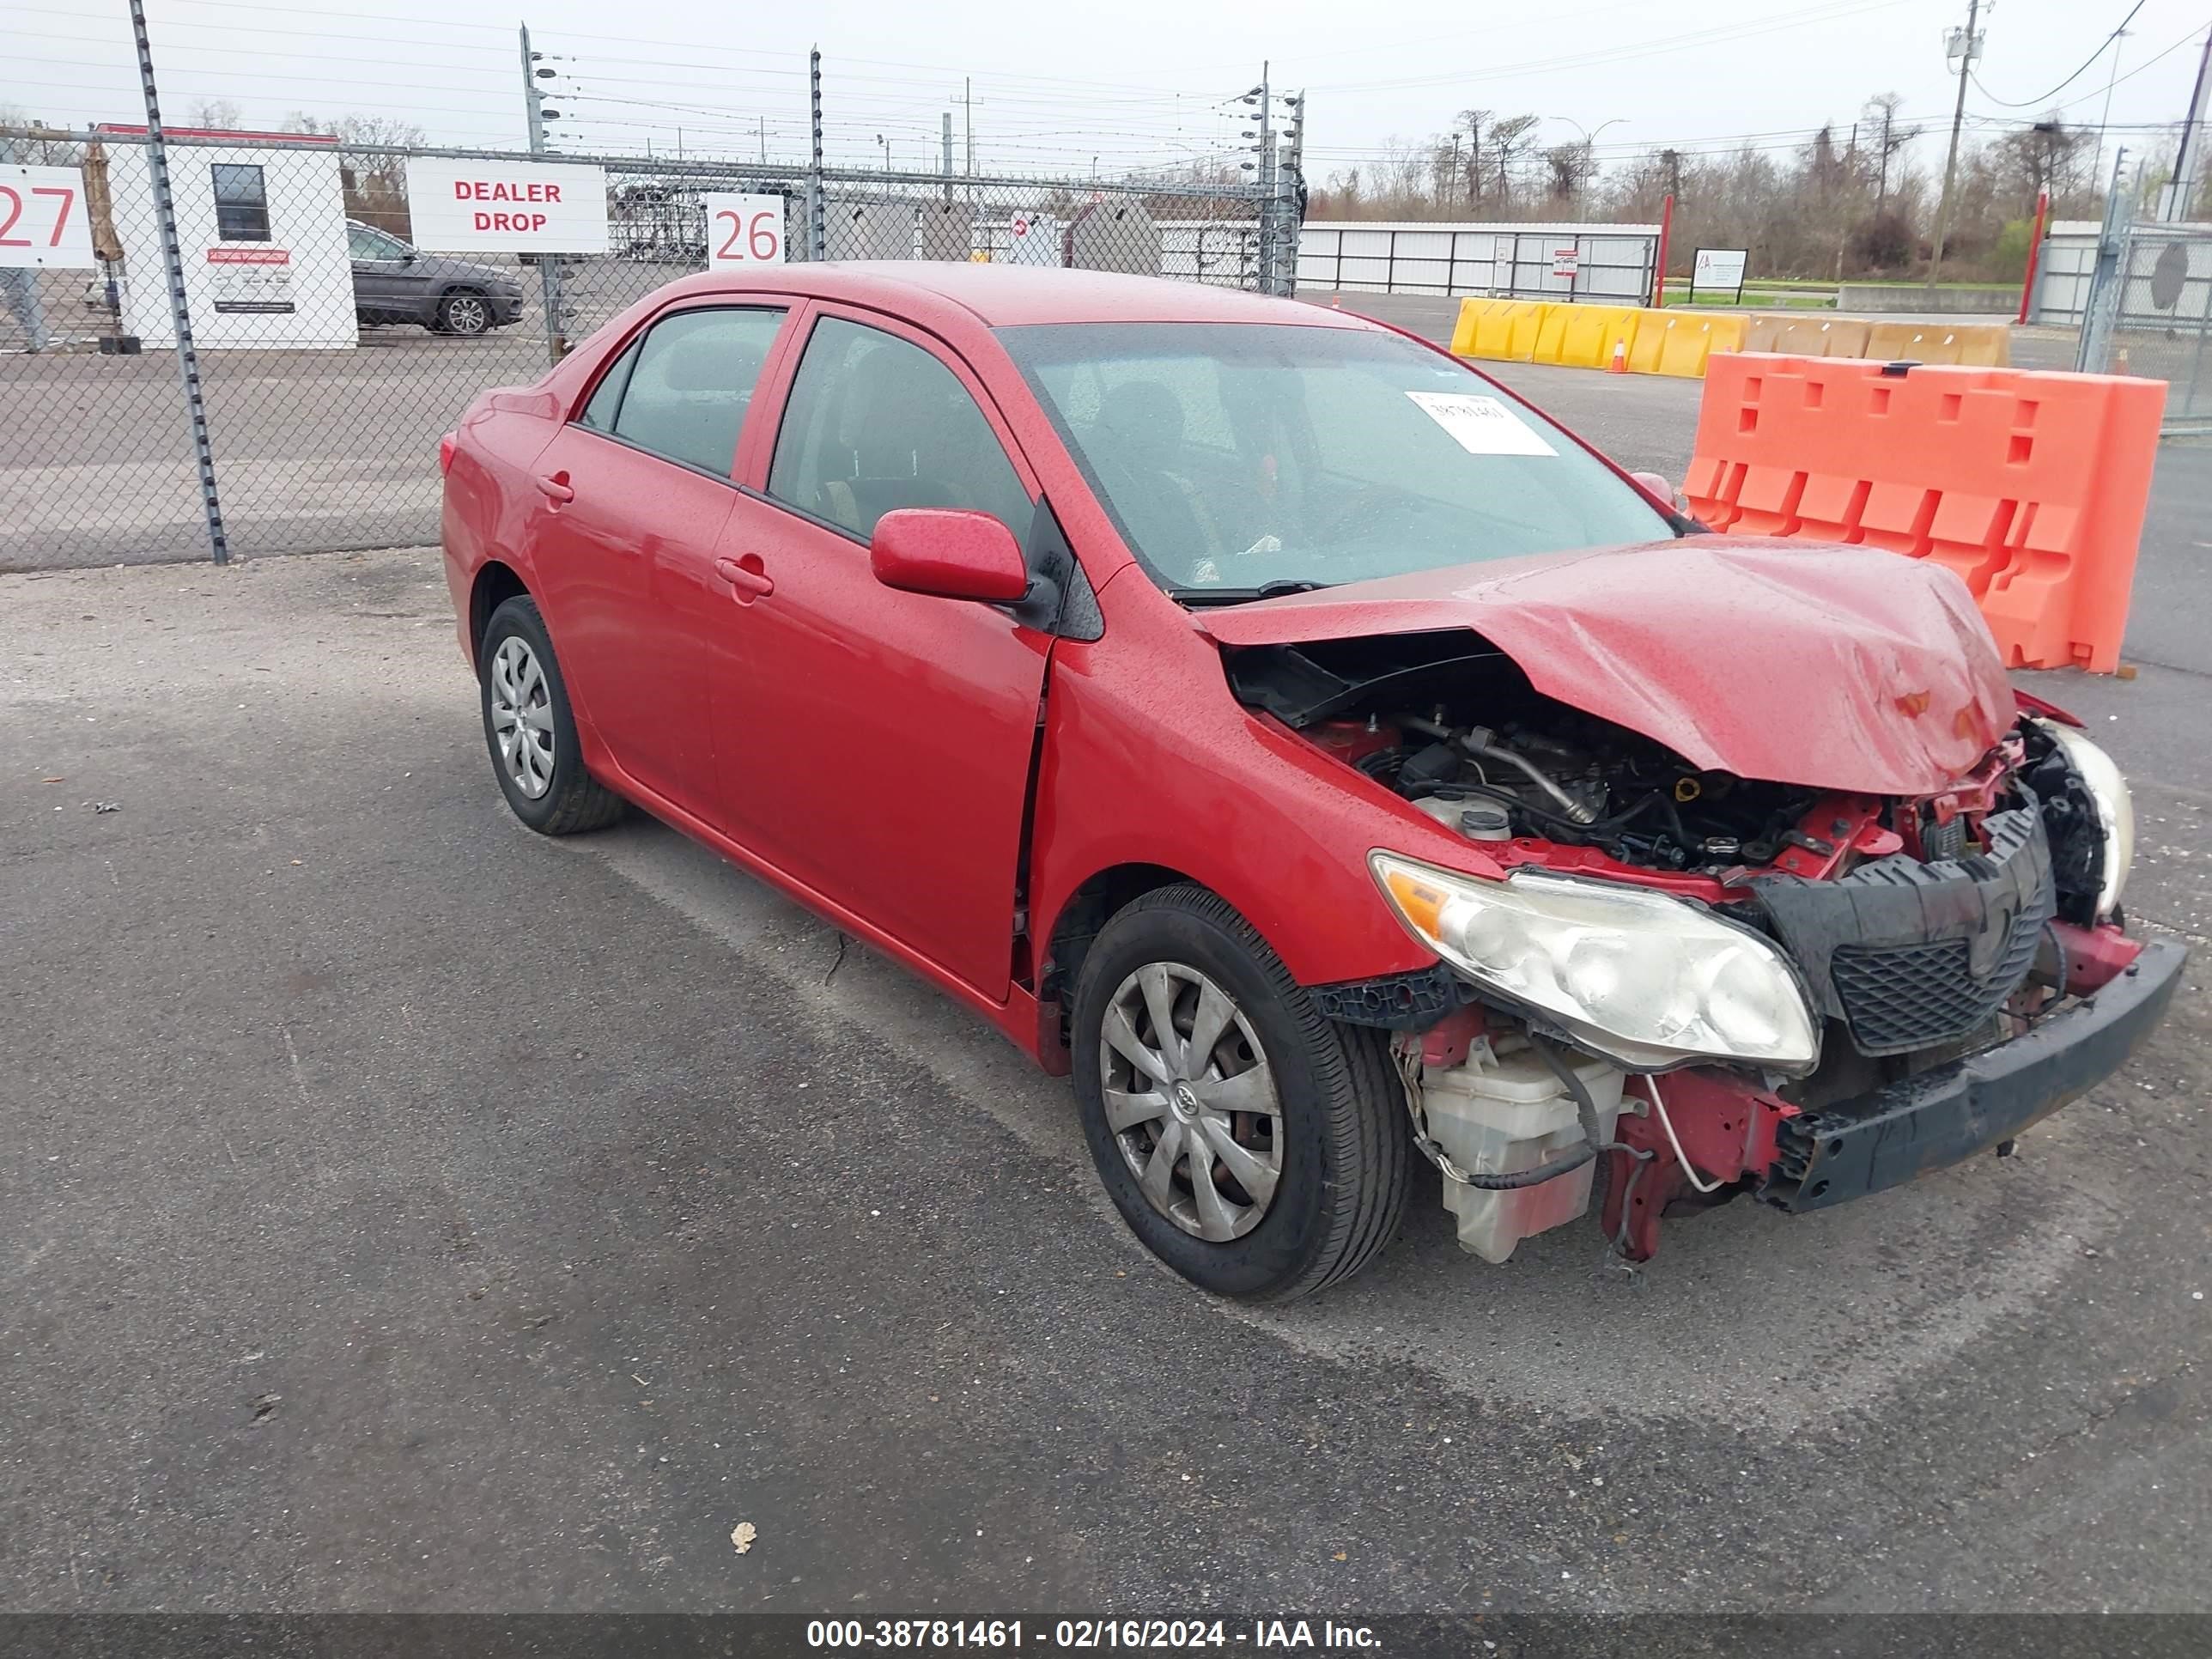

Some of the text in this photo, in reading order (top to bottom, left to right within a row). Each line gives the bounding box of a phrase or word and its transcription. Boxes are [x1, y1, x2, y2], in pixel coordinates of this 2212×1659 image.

[454, 180, 562, 203] DEALER
[0, 185, 74, 247] 27
[473, 211, 547, 233] DROP
[715, 210, 778, 261] 26
